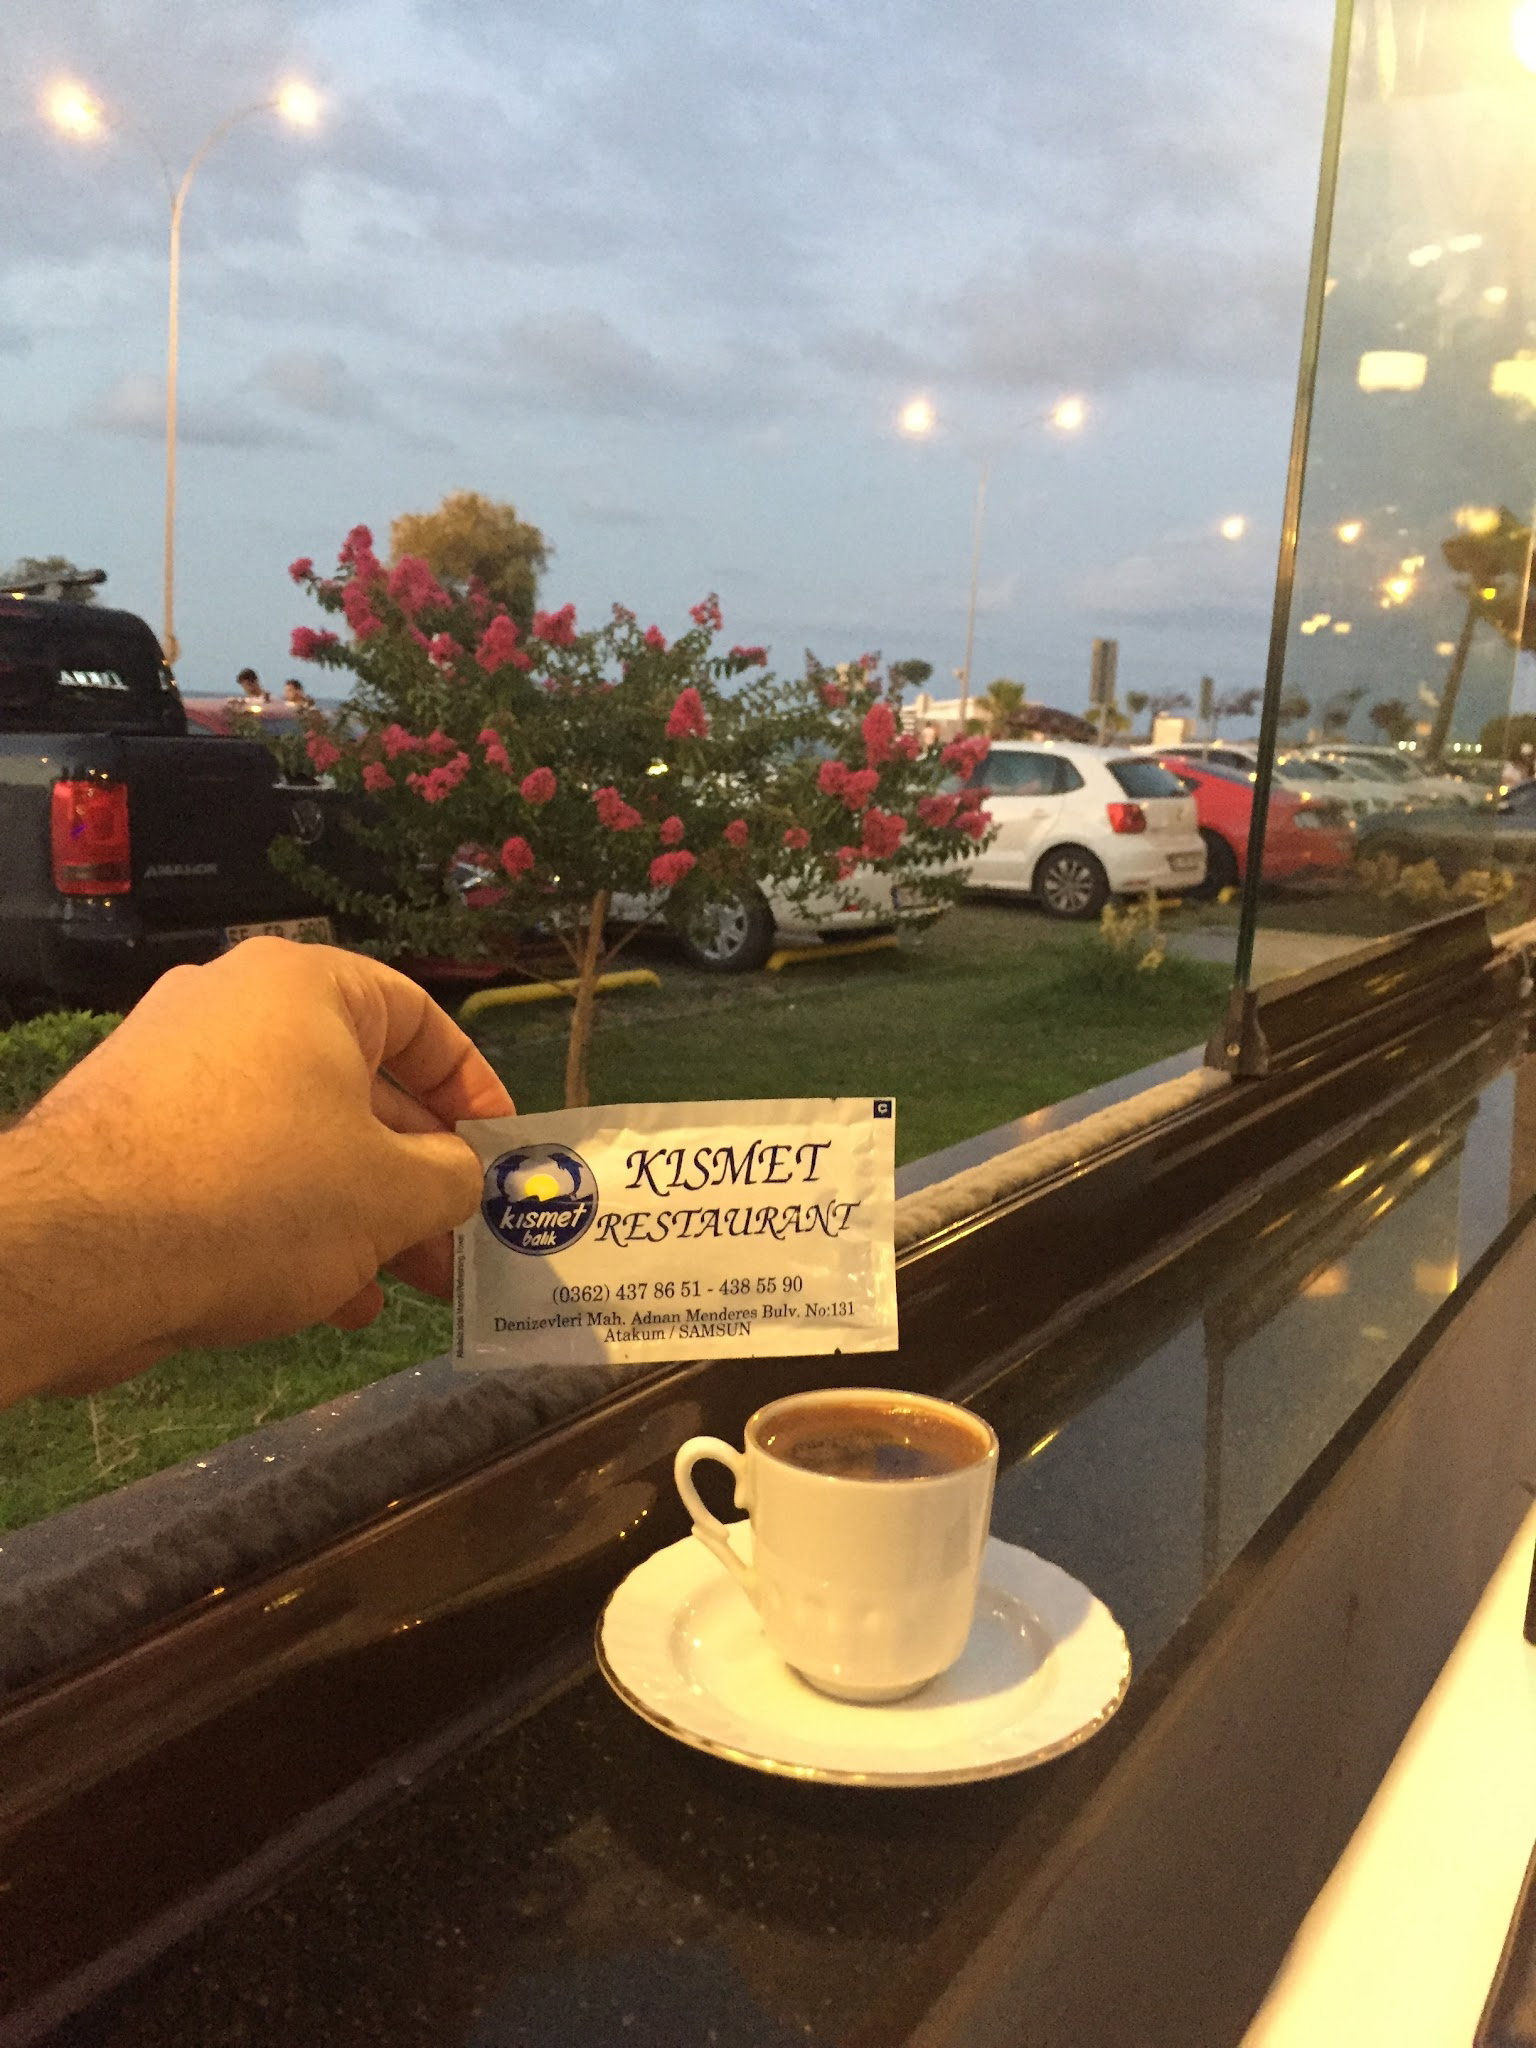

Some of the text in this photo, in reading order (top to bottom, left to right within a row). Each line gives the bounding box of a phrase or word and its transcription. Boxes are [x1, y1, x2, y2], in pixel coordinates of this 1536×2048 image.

[625, 1139, 832, 1197] KISMET
[594, 1199, 861, 1248] RESTAURANT
[552, 1284, 611, 1305] (0362)
[615, 1283, 648, 1300] 437
[653, 1281, 675, 1299] 86
[680, 1280, 701, 1298] 51
[718, 1278, 751, 1296] 438
[756, 1277, 778, 1294] 55
[782, 1275, 803, 1293] 90
[494, 1300, 855, 1333] Denizevleri Mah. Adnan Menderes Bulv. No:131
[603, 1326, 665, 1343] Atakum
[678, 1321, 752, 1340] SAMSUN
